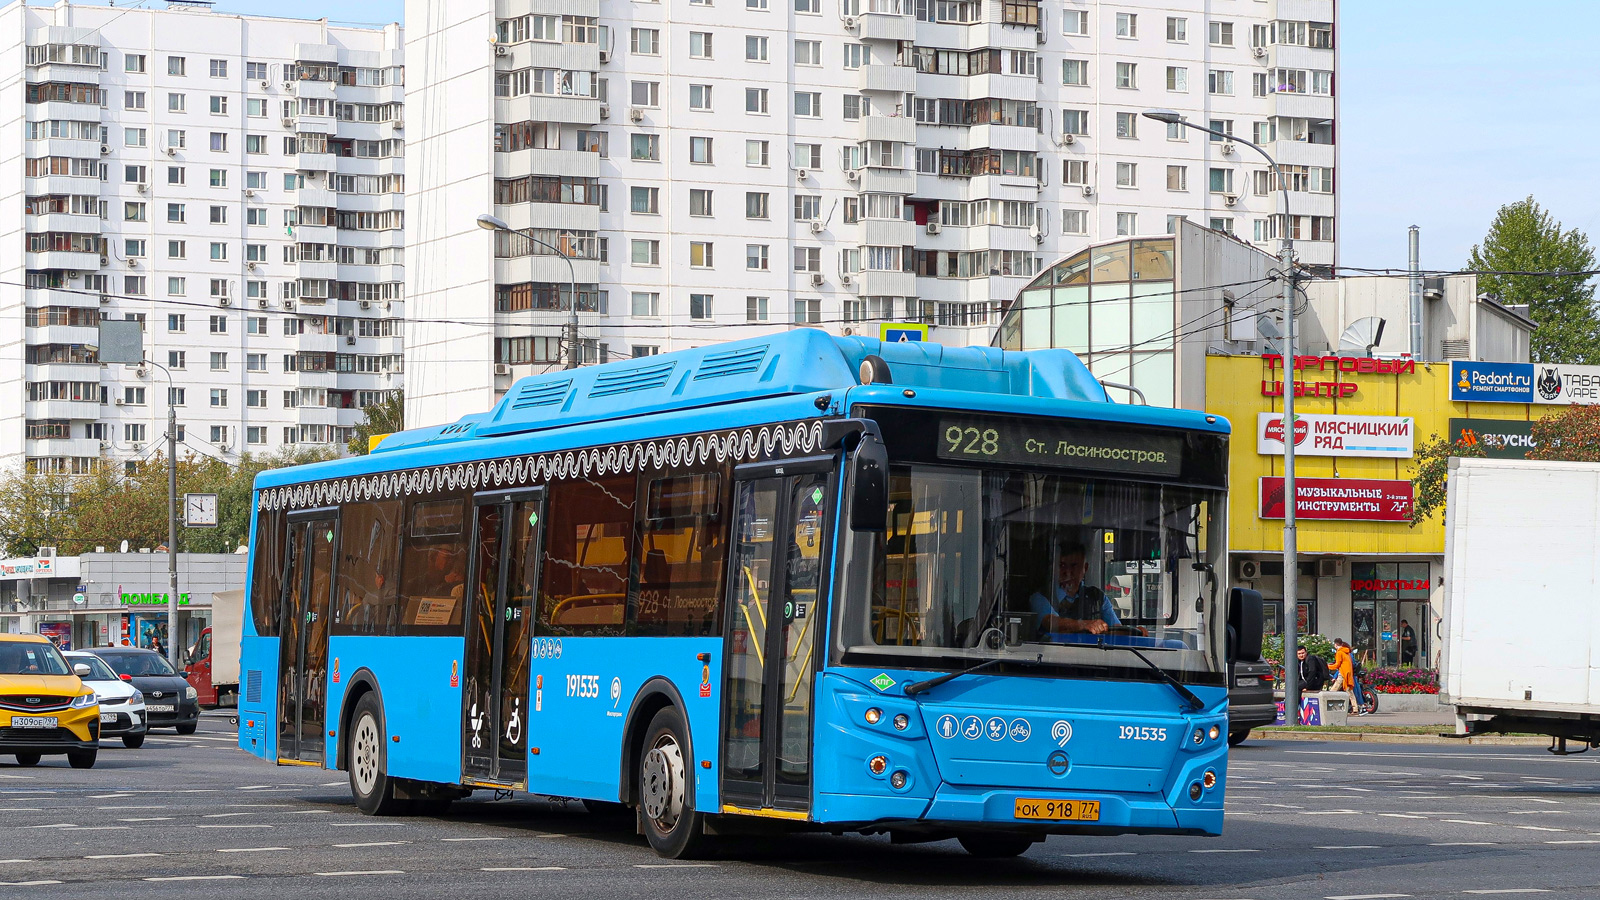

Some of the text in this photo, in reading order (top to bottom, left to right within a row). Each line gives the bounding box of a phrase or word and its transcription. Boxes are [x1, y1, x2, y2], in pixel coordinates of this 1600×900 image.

[1472, 370, 1530, 386] Pedant.ru
[1565, 387, 1598, 399] VAPE
[1267, 426, 1306, 434] МЯСНКИЙ
[1314, 419, 1408, 437] МЯСНИЦКИЙ
[945, 425, 999, 455] 928
[1314, 436, 1343, 450] РЯД
[1025, 438, 1168, 464] Ст. Лосиноостров.
[1297, 487, 1382, 499] МУЗЫКАЛЬНЫЕ
[1297, 500, 1380, 512] ИНСТРУМЕНТЫ
[1350, 579, 1430, 591] ПРОДУКТЫ 24
[121, 593, 189, 605] ЛОМБАД
[639, 590, 659, 614] 928
[566, 674, 600, 698] 191535
[875, 678, 890, 686] КПГ
[1118, 725, 1167, 741] 191535
[1022, 802, 1095, 817] ОК 918 77
